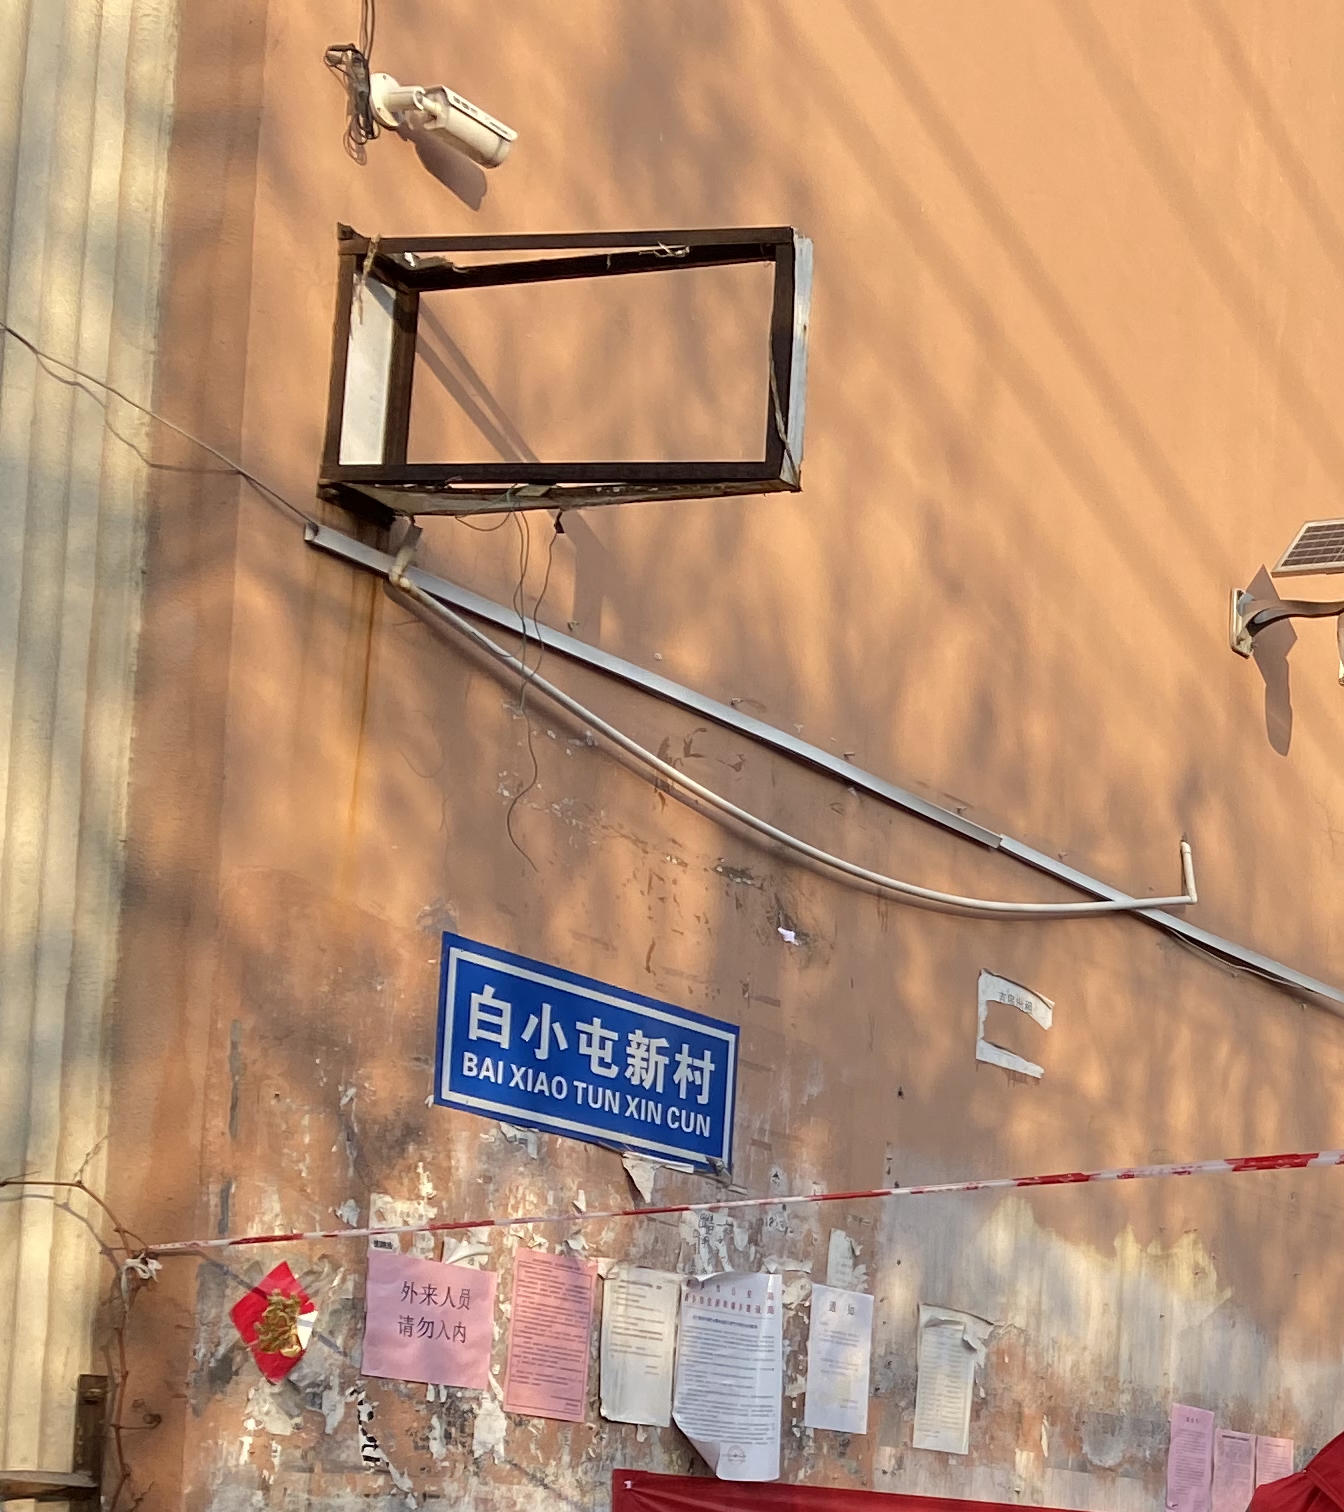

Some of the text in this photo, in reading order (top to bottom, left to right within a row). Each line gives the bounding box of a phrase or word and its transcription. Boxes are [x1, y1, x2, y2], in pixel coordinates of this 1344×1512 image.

[468, 983, 715, 1105] 白小屯新村
[462, 1052, 711, 1138] BAI XIAO TUN XIN CUN
[400, 1281, 471, 1310] 外来人员
[397, 1315, 467, 1344] 请勿入内
